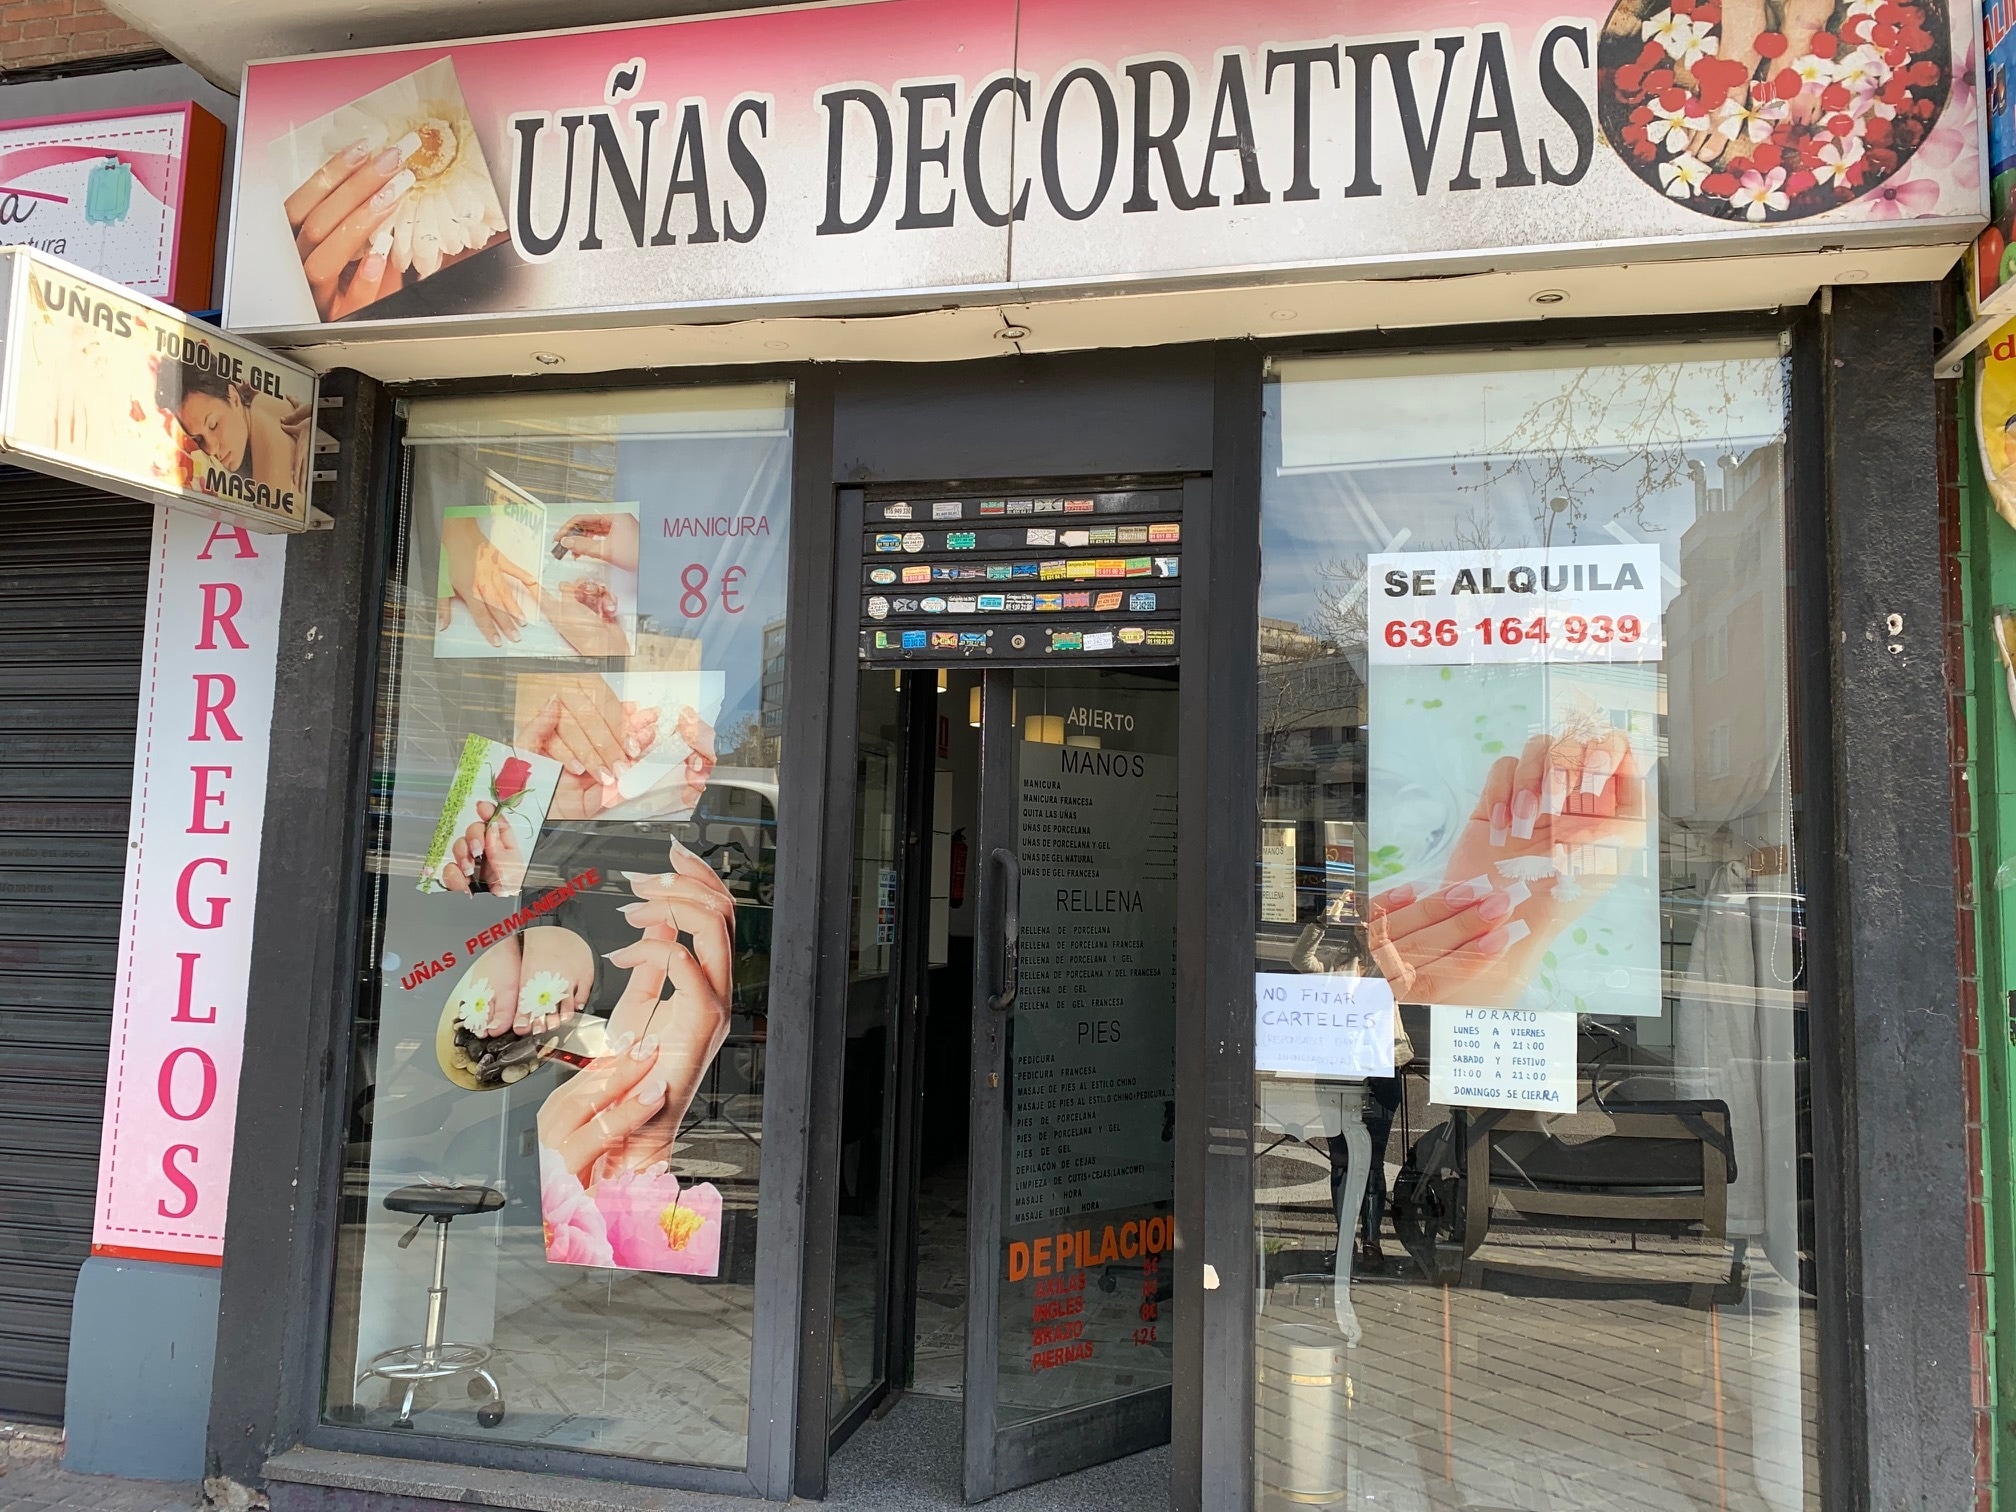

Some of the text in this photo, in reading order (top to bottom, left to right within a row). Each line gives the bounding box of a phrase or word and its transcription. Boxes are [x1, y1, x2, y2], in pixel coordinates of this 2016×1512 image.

[514, 24, 1595, 257] UÑAS DECORATIVAS
[43, 279, 284, 400] UÑAS TODO DE GEL
[205, 467, 294, 515] MASAJE
[663, 515, 770, 538] MANICURA
[1384, 562, 1643, 597] SE ALQUILA
[1384, 614, 1642, 647] 636 164 939
[1067, 706, 1134, 732] ABIERTO
[1061, 749, 1144, 777] MANOS
[1023, 779, 1061, 790] MANICURA
[1023, 794, 1093, 806] MANICURA FRANCESA
[1023, 808, 1077, 820] QUITA LAS UÑAS
[1022, 822, 1090, 835] UÑAS DE PORCELANA
[1022, 836, 1040, 847] UÑAS
[1042, 838, 1050, 847] DE
[1052, 840, 1090, 850] PORCELANA
[1098, 842, 1110, 850] GEL
[1022, 852, 1094, 864] UÑAS DE GEL NATURAL
[157, 521, 259, 1220] ARREGLOS
[1022, 866, 1100, 878] UÑAS DE GEL FRANCESA
[1056, 889, 1143, 912] RELLENA
[400, 866, 601, 991] UÑAS PERMANENTE
[1020, 926, 1111, 935] RELLENA DE PORCELANA
[1020, 940, 1144, 950] RELLENA DE PORCELANA FRANCESA
[1020, 956, 1050, 965] RELLENA
[1056, 956, 1064, 964] DE
[1070, 955, 1107, 964] PORCELANA
[1122, 954, 1134, 963] GEL
[1020, 971, 1050, 980] RELLENA
[1054, 970, 1062, 979] DE
[1066, 970, 1104, 979] PORCELANA
[1130, 968, 1162, 976] FRANCESA
[1020, 984, 1087, 996] RELLENA DE GEL
[1263, 987, 1356, 1005] NO FIJAR
[1019, 998, 1124, 1010] RELLENA DE GEL FRANCESA
[1261, 1010, 1376, 1029] CARTELES
[1465, 1009, 1537, 1023] HORARIO
[1077, 1020, 1121, 1045] PIES
[1453, 1026, 1546, 1038] LUNES A VIERNES
[1454, 1040, 1480, 1049] 10:00
[1494, 1042, 1500, 1050] A
[1018, 1054, 1056, 1065] PEDICURA
[1452, 1054, 1546, 1067] SABADO Y FESTIVO
[1018, 1066, 1097, 1080] PEDICURA FRANCESA
[1453, 1068, 1482, 1078] 11:00
[1496, 1070, 1502, 1079] A
[1018, 1077, 1136, 1096] MASAJE DE PIES AL ESTILO CHINO
[1454, 1086, 1560, 1102] DOMINGOS SE CIERRA
[1018, 1101, 1044, 1112] MASAJE
[1048, 1100, 1056, 1108] DE
[1060, 1098, 1074, 1107] PIES
[1077, 1096, 1085, 1106] AL
[1088, 1094, 1112, 1104] ESTILO
[1017, 1111, 1096, 1128] PIES DE PORCELANA
[1016, 1124, 1120, 1144] PIES DE PORCELANA Y GEL
[1016, 1144, 1072, 1160] PIES DE GEL
[1016, 1156, 1096, 1175] DEPILACON DE CEJAS
[1016, 1178, 1047, 1191] LIMPIEZA
[1054, 1177, 1062, 1186] DE
[1016, 1194, 1044, 1206] MASAJE
[1064, 1189, 1082, 1200] HORA
[1016, 1201, 1100, 1222] MASAJE MEDIA HORA
[1034, 1272, 1087, 1299] AXILAS
[1032, 1296, 1084, 1323] INGLES
[1032, 1320, 1084, 1347] BRAZO
[1032, 1341, 1094, 1372] PIERNAS
